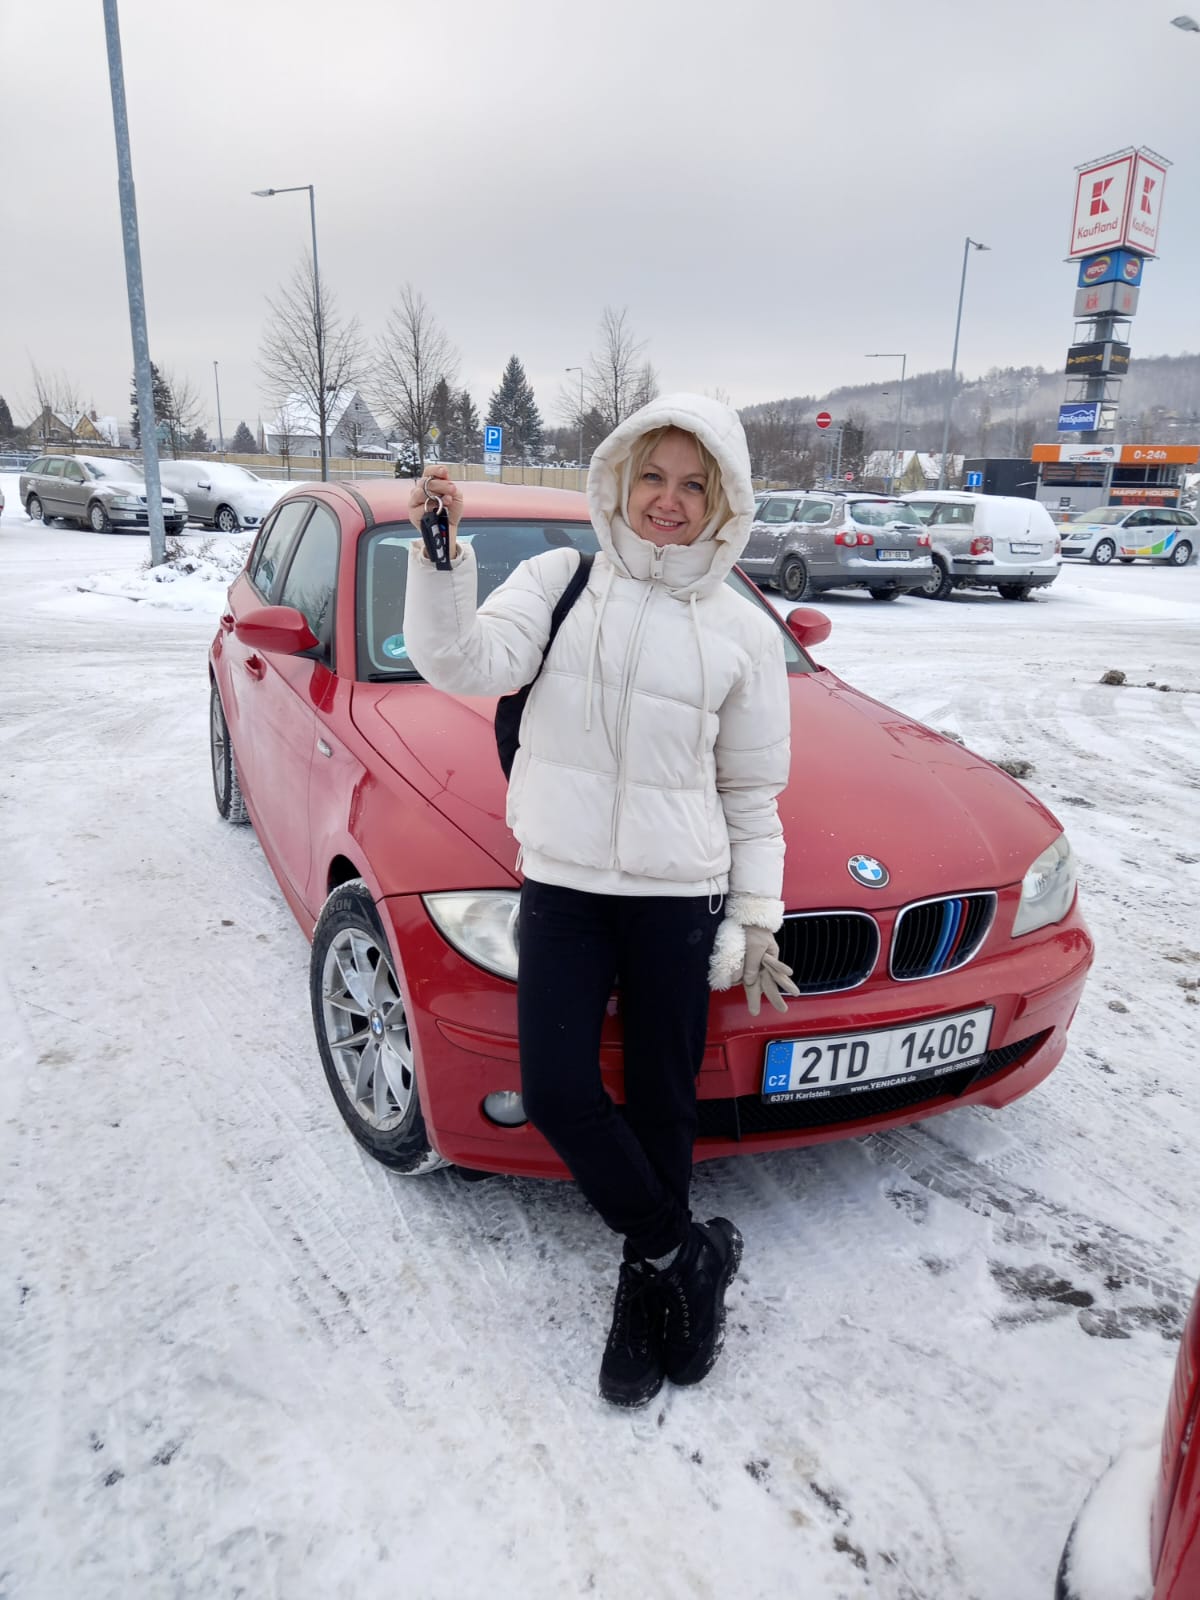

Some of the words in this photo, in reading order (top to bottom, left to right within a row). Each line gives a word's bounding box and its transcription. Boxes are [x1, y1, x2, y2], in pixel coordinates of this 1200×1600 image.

[1077, 217, 1119, 239] Kaufland
[1132, 217, 1156, 238] Kaufland
[488, 430, 498, 444] P
[1113, 489, 1143, 497] HAPPY
[798, 1040, 870, 1085] 2TD
[901, 1019, 977, 1068] 1406
[768, 1074, 786, 1087] CZ
[850, 1074, 917, 1093] www.YENICAR.de
[770, 1093, 794, 1103] 63791
[795, 1089, 831, 1100] Karlstein
